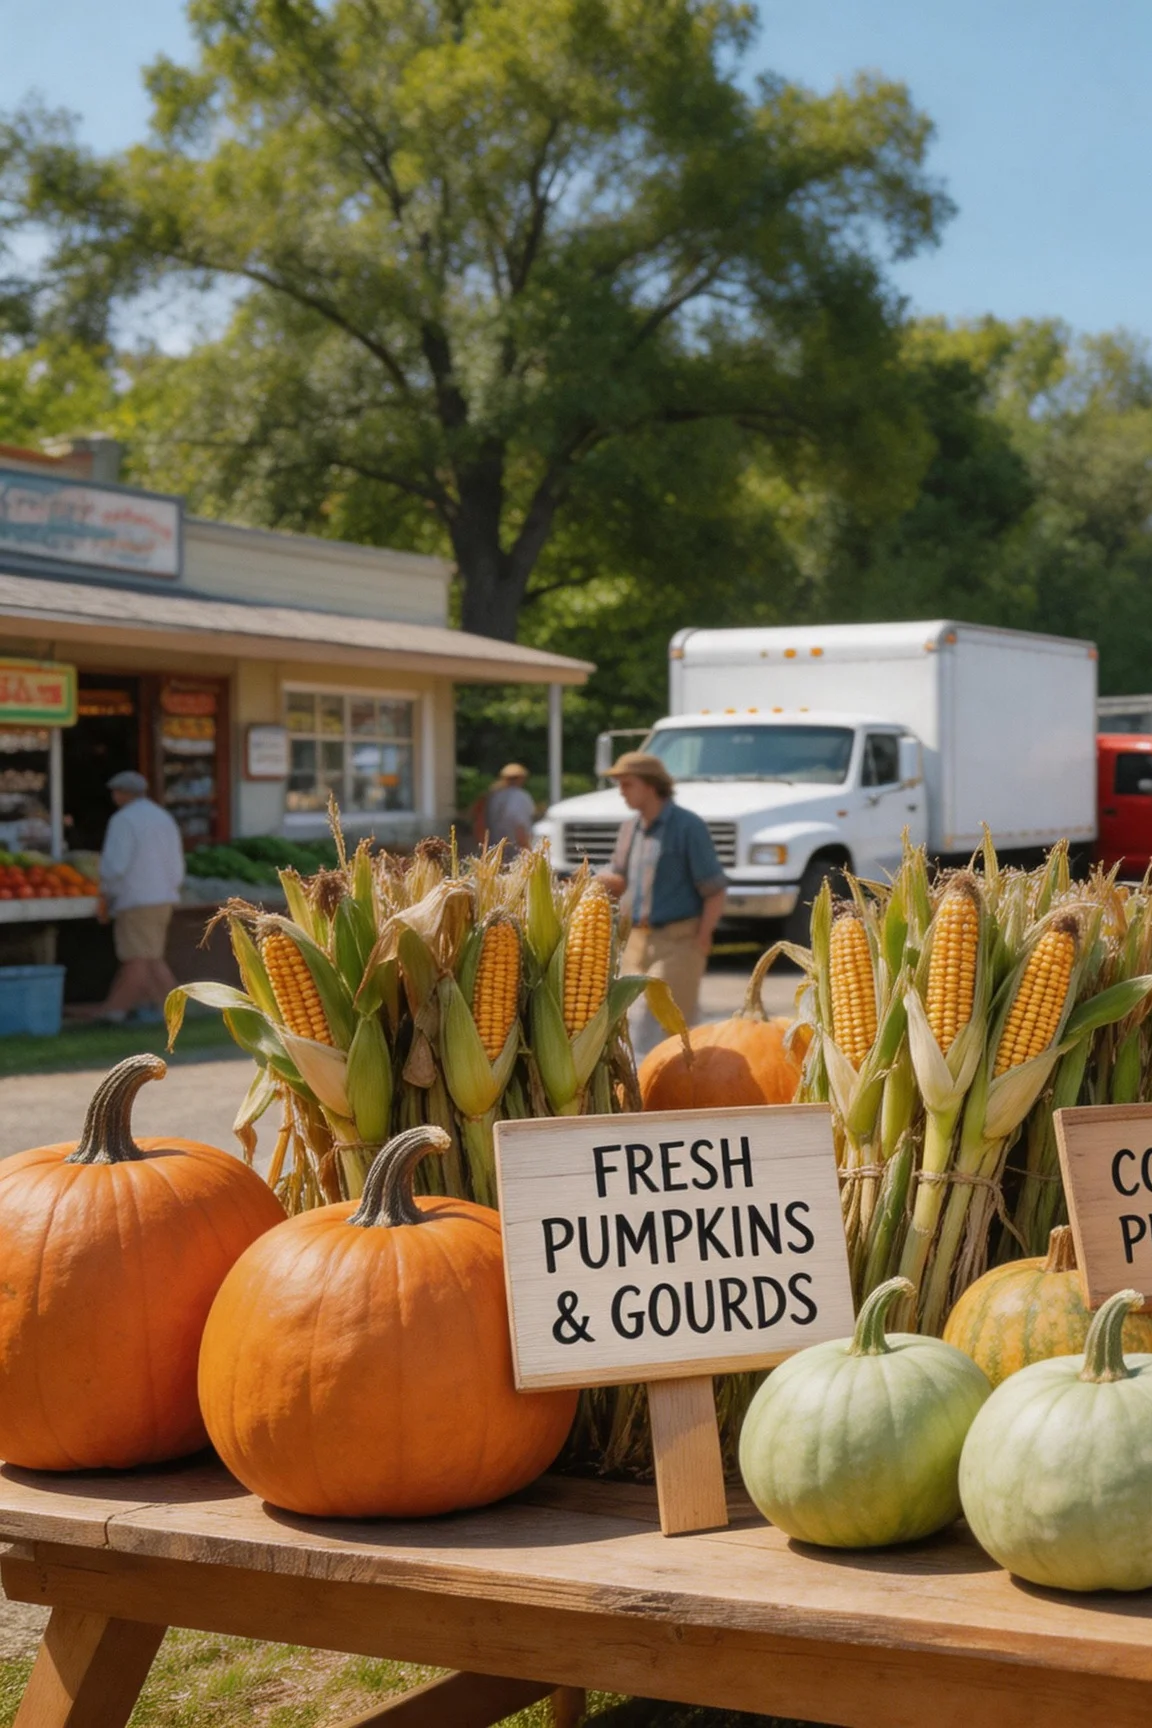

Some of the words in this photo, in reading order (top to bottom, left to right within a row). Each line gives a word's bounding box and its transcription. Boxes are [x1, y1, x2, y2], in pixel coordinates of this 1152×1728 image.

[592, 1136, 754, 1198] FRESH
[541, 1200, 815, 1274] PUMPKINS
[551, 1289, 596, 1345] &
[610, 1272, 818, 1340] GOURDS
